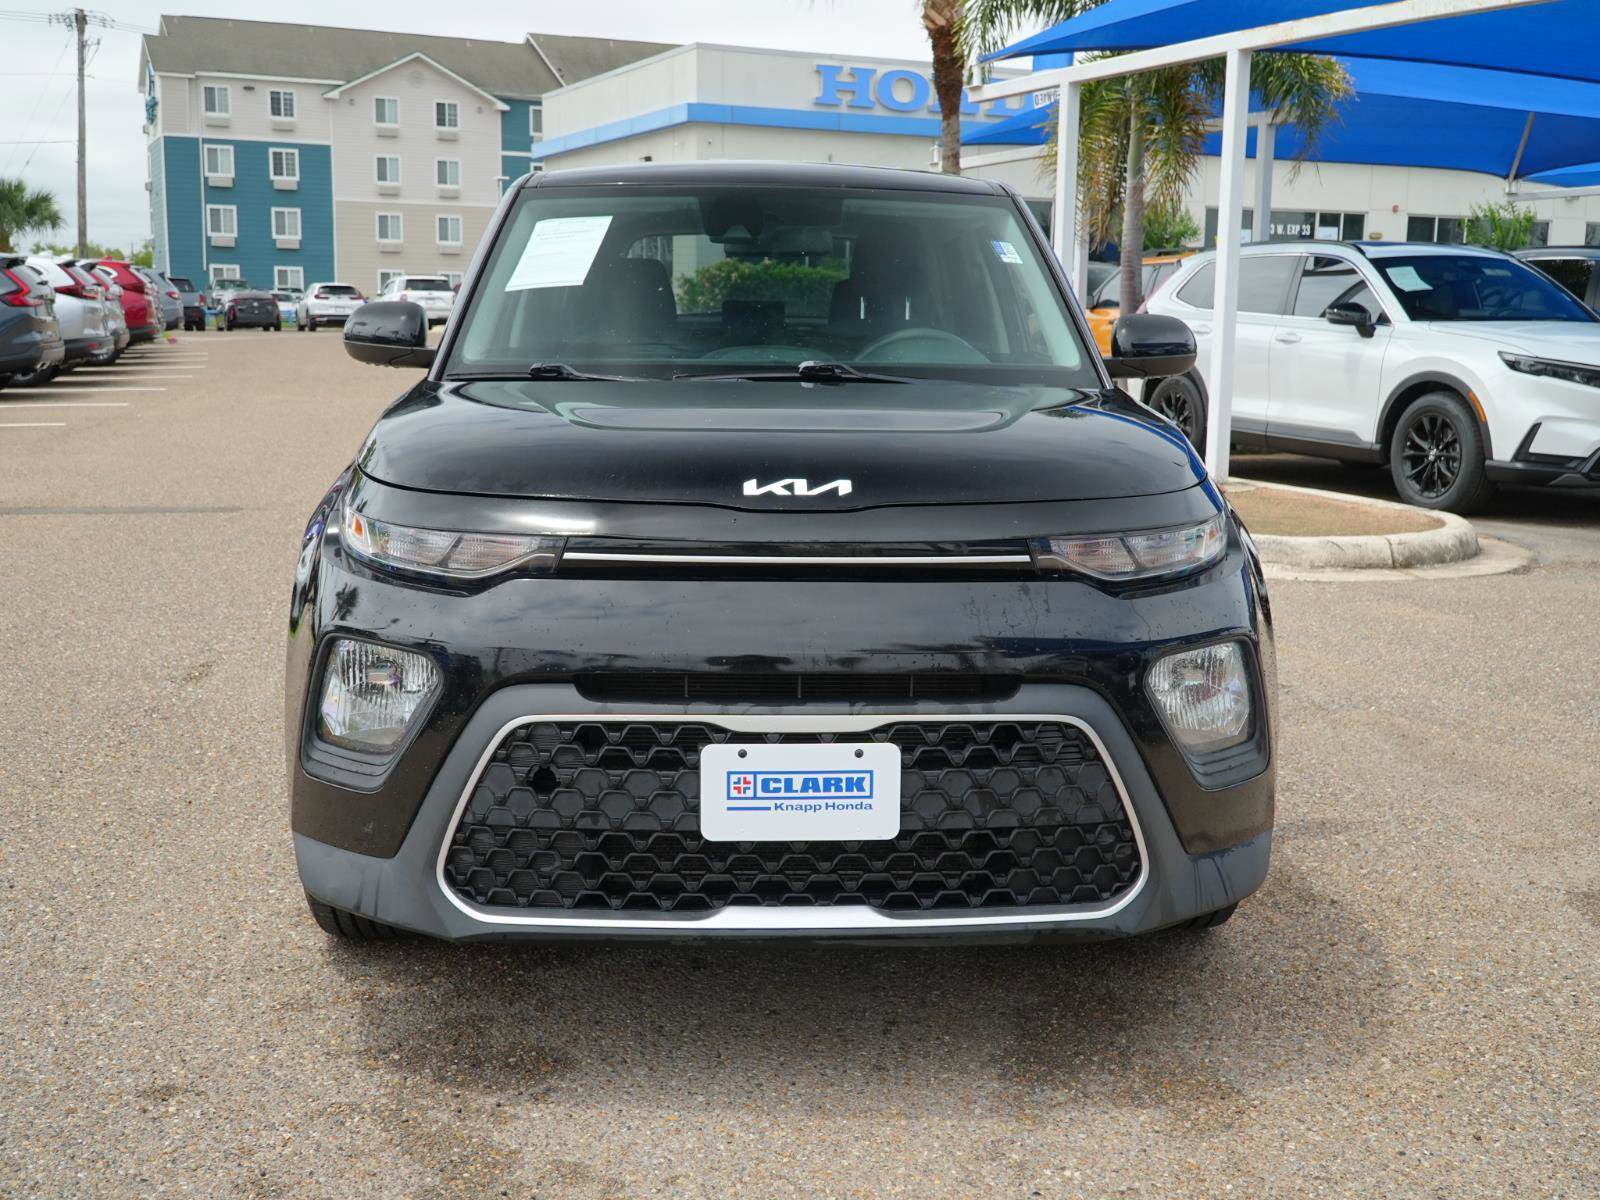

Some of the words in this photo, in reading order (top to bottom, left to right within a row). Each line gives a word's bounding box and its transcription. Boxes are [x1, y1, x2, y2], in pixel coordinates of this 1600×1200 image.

[1287, 223, 1300, 236] EXP
[743, 478, 852, 496] KIA
[760, 776, 867, 794] CLARK
[774, 802, 822, 813] Knapp
[825, 801, 873, 811] Honda
